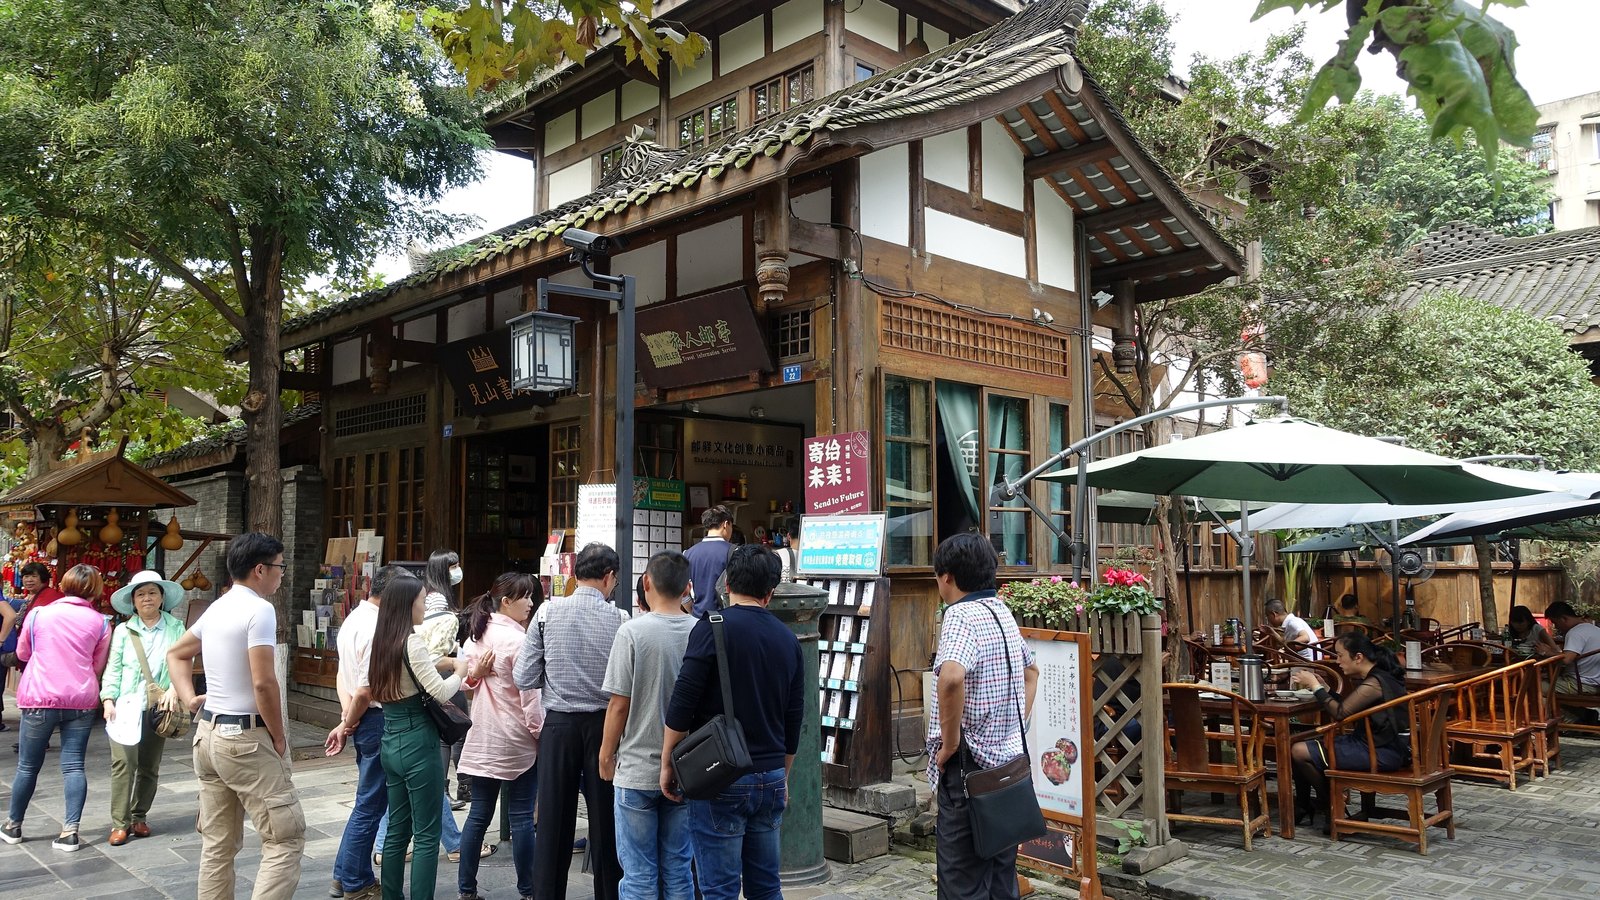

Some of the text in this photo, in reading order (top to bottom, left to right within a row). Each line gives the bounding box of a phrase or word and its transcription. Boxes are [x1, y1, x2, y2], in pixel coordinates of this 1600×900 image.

[653, 351, 680, 363] TRAVELER
[696, 350, 720, 359] Information
[721, 346, 737, 354] Service
[808, 438, 841, 464] 寄给
[808, 463, 842, 489] 未来
[813, 498, 832, 510] Send
[839, 490, 865, 503] Future
